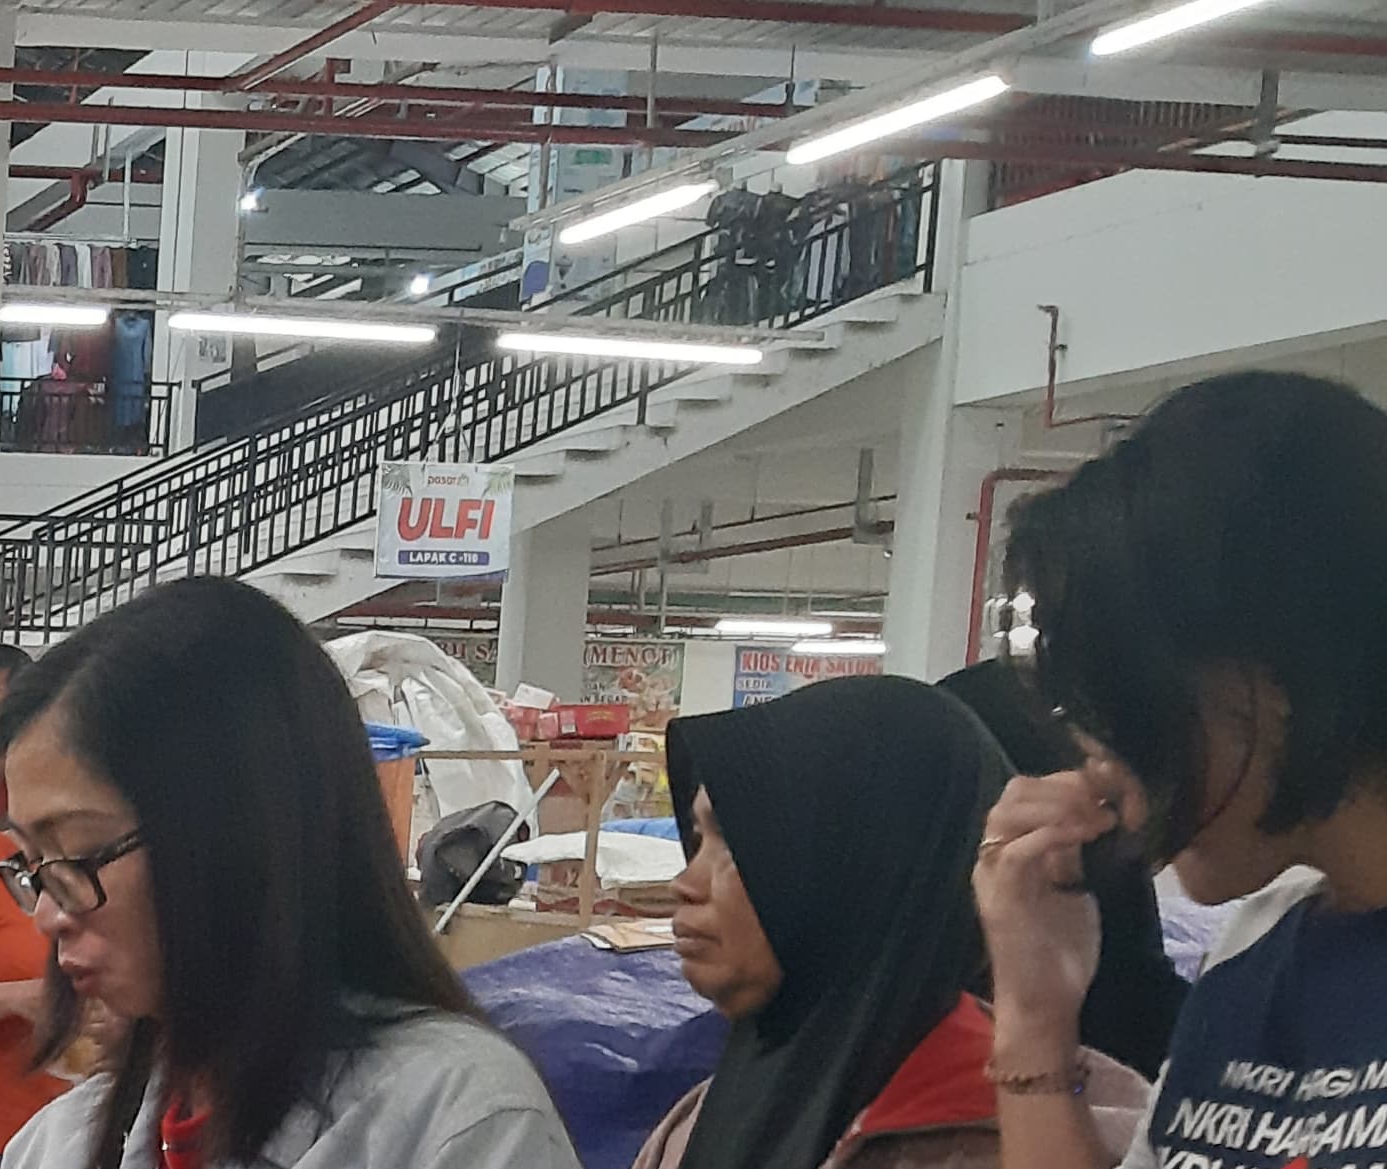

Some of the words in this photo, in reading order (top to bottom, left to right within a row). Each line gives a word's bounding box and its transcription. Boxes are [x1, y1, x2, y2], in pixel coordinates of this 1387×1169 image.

[397, 497, 496, 542] ULFI
[409, 551, 444, 564] LAPAK
[741, 651, 779, 673] KIOS
[1165, 1097, 1254, 1150] NKRI
